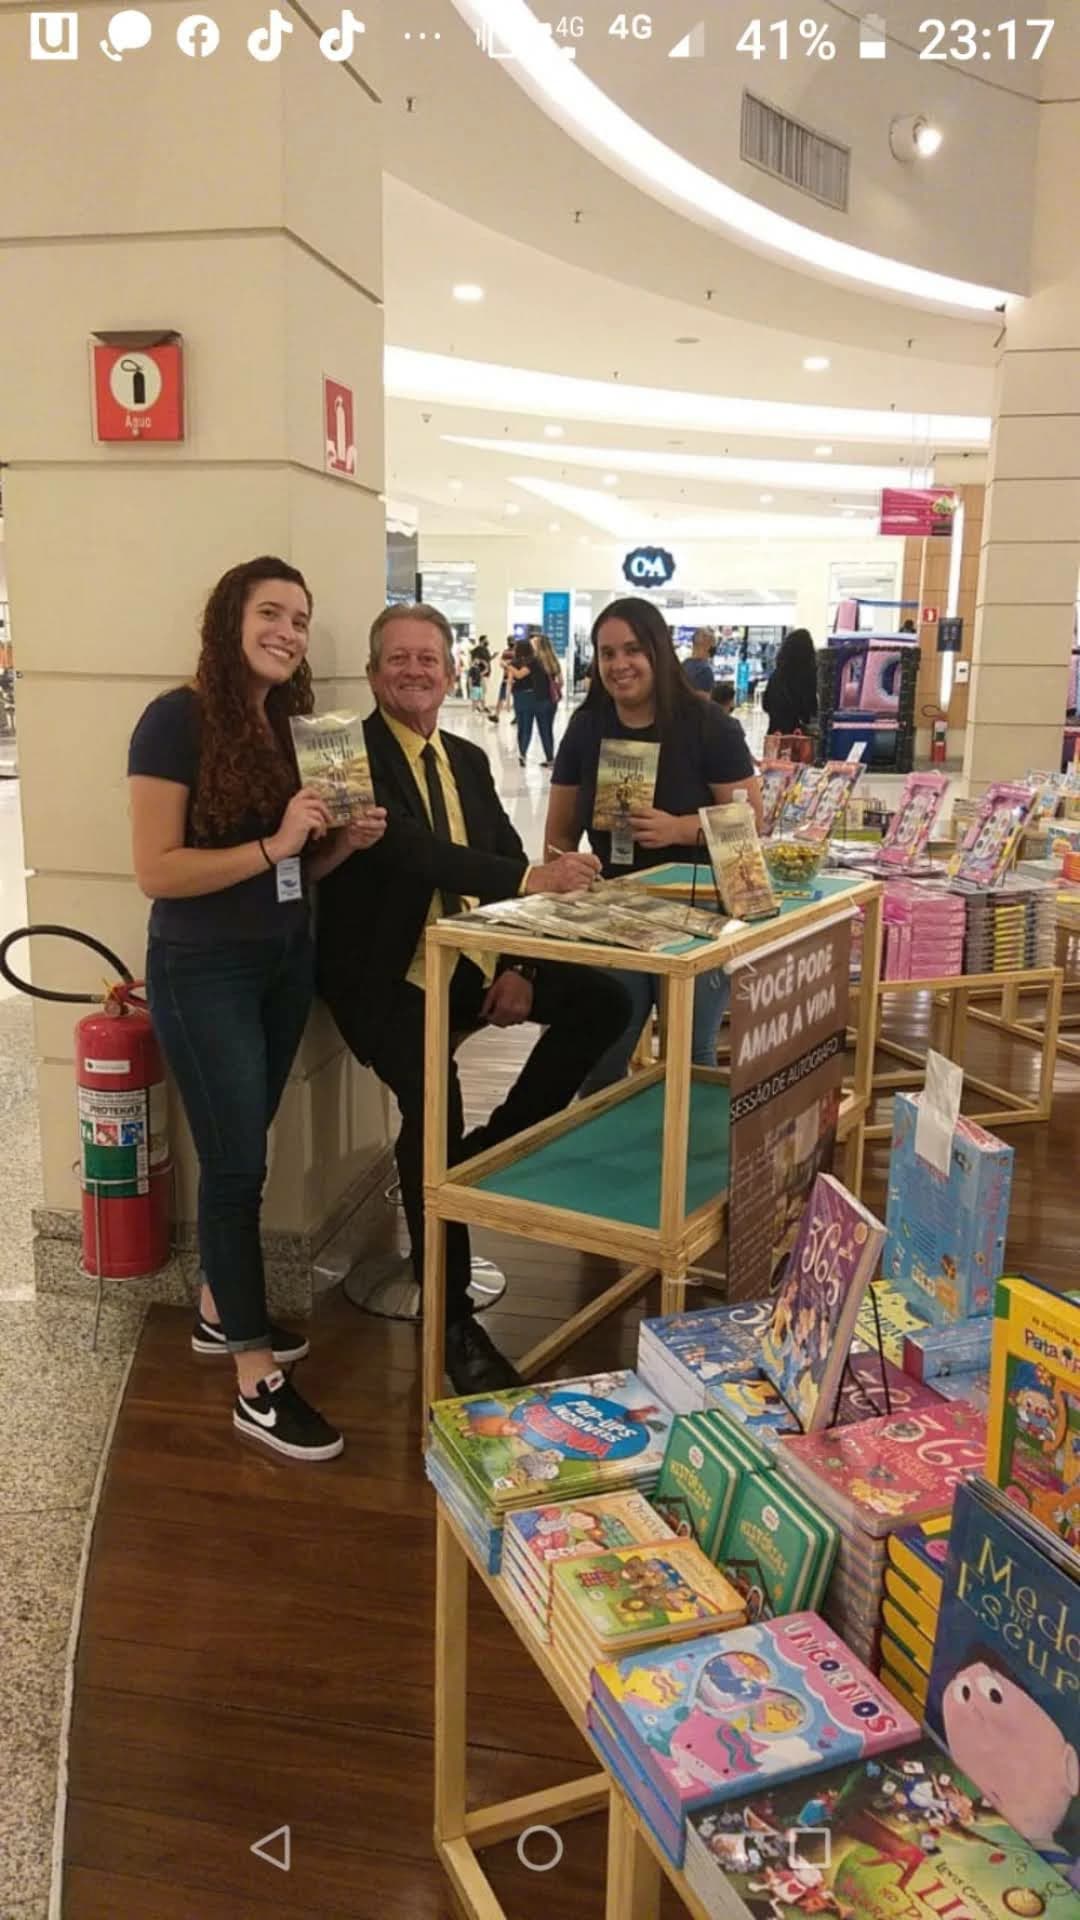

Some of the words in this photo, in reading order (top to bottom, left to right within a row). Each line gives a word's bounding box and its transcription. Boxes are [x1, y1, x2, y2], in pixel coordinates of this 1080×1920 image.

[750, 952, 795, 1012] VOCÊ
[797, 943, 833, 988] PODE
[738, 1012, 788, 1067] AMAR
[791, 1005, 803, 1036] A
[806, 984, 836, 1025] VIDA
[730, 1083, 772, 1121] SESSÃO
[772, 1073, 787, 1096] DE
